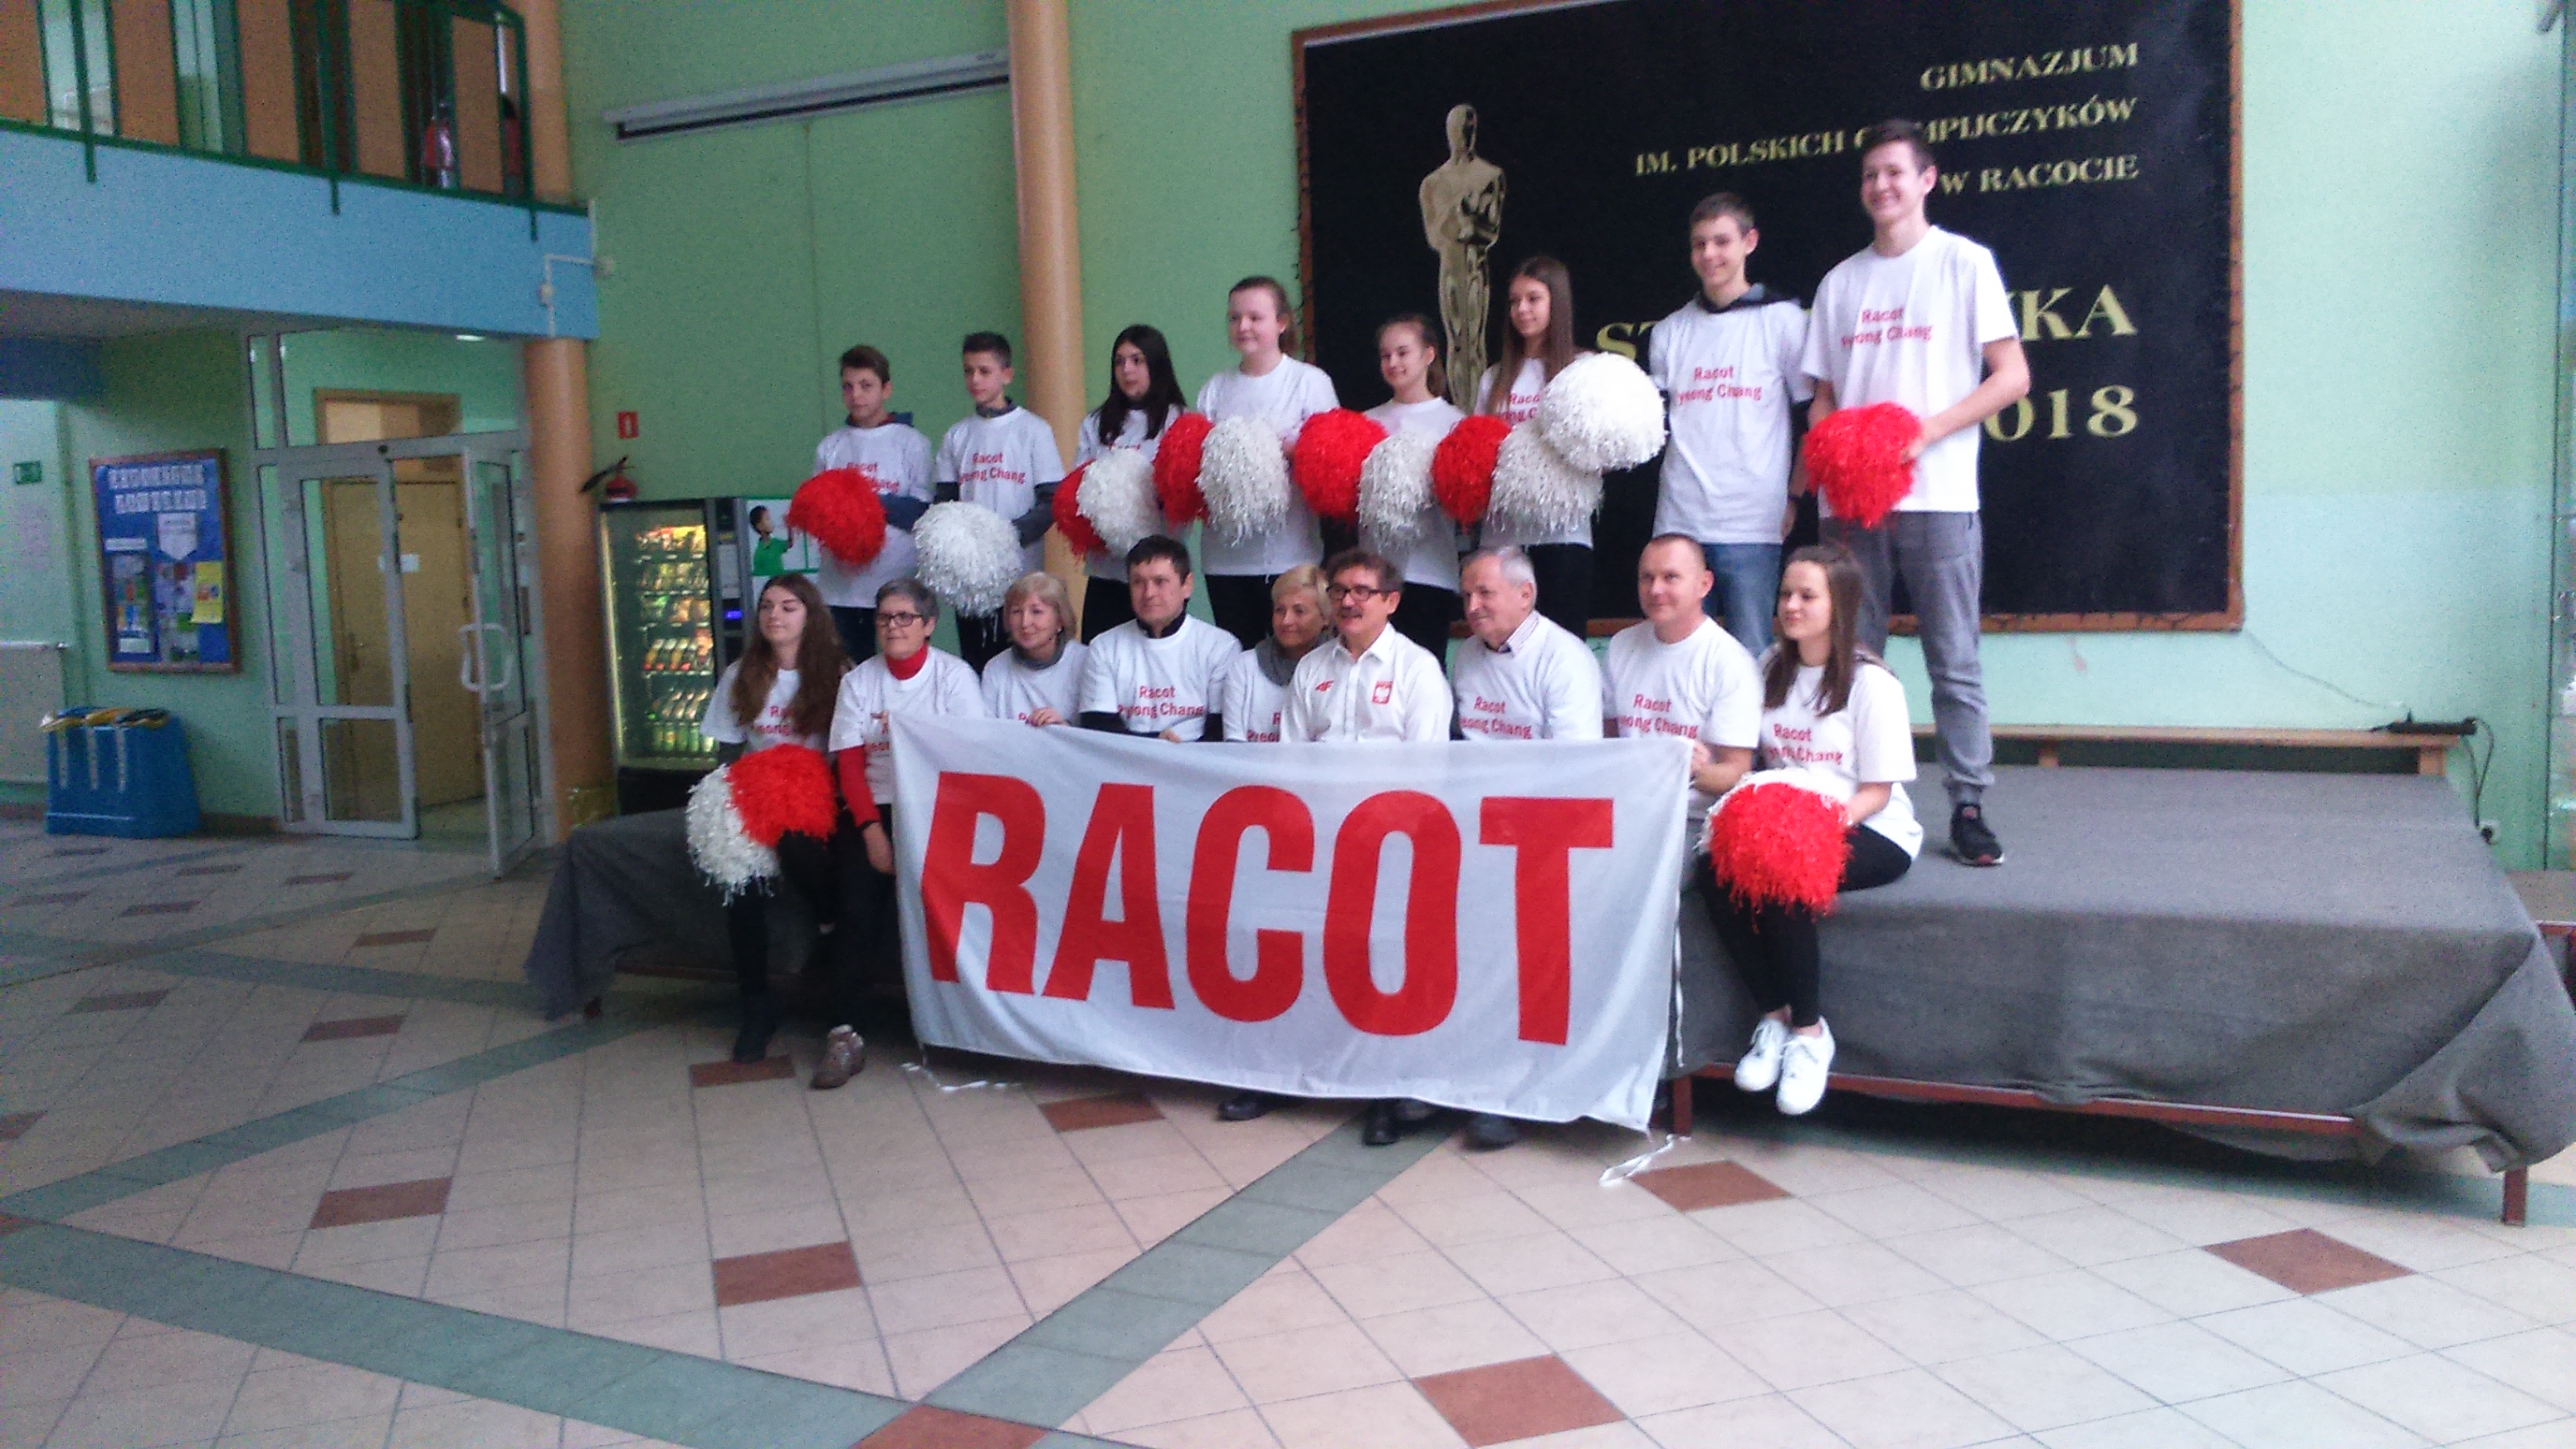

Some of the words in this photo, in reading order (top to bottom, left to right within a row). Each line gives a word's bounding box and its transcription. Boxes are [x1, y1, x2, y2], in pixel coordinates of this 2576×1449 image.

[1920, 42, 2139, 92] GIMNAZJUM
[1636, 151, 1677, 176] IM.
[1686, 129, 1845, 169] POLSKICH
[1940, 171, 1970, 195] W
[1979, 154, 2139, 193] RACOCIE
[1694, 365, 1734, 381] Racot
[1509, 393, 1540, 405] Raco
[1984, 384, 2139, 442] 018
[1139, 685, 1176, 699] Racot
[1474, 696, 1505, 714] Racot
[1633, 694, 1672, 713] Racot
[1492, 718, 1532, 739] Chang
[1655, 718, 1698, 739] Chang
[1773, 724, 1812, 741] Racot
[922, 771, 1613, 1046] RACOT
